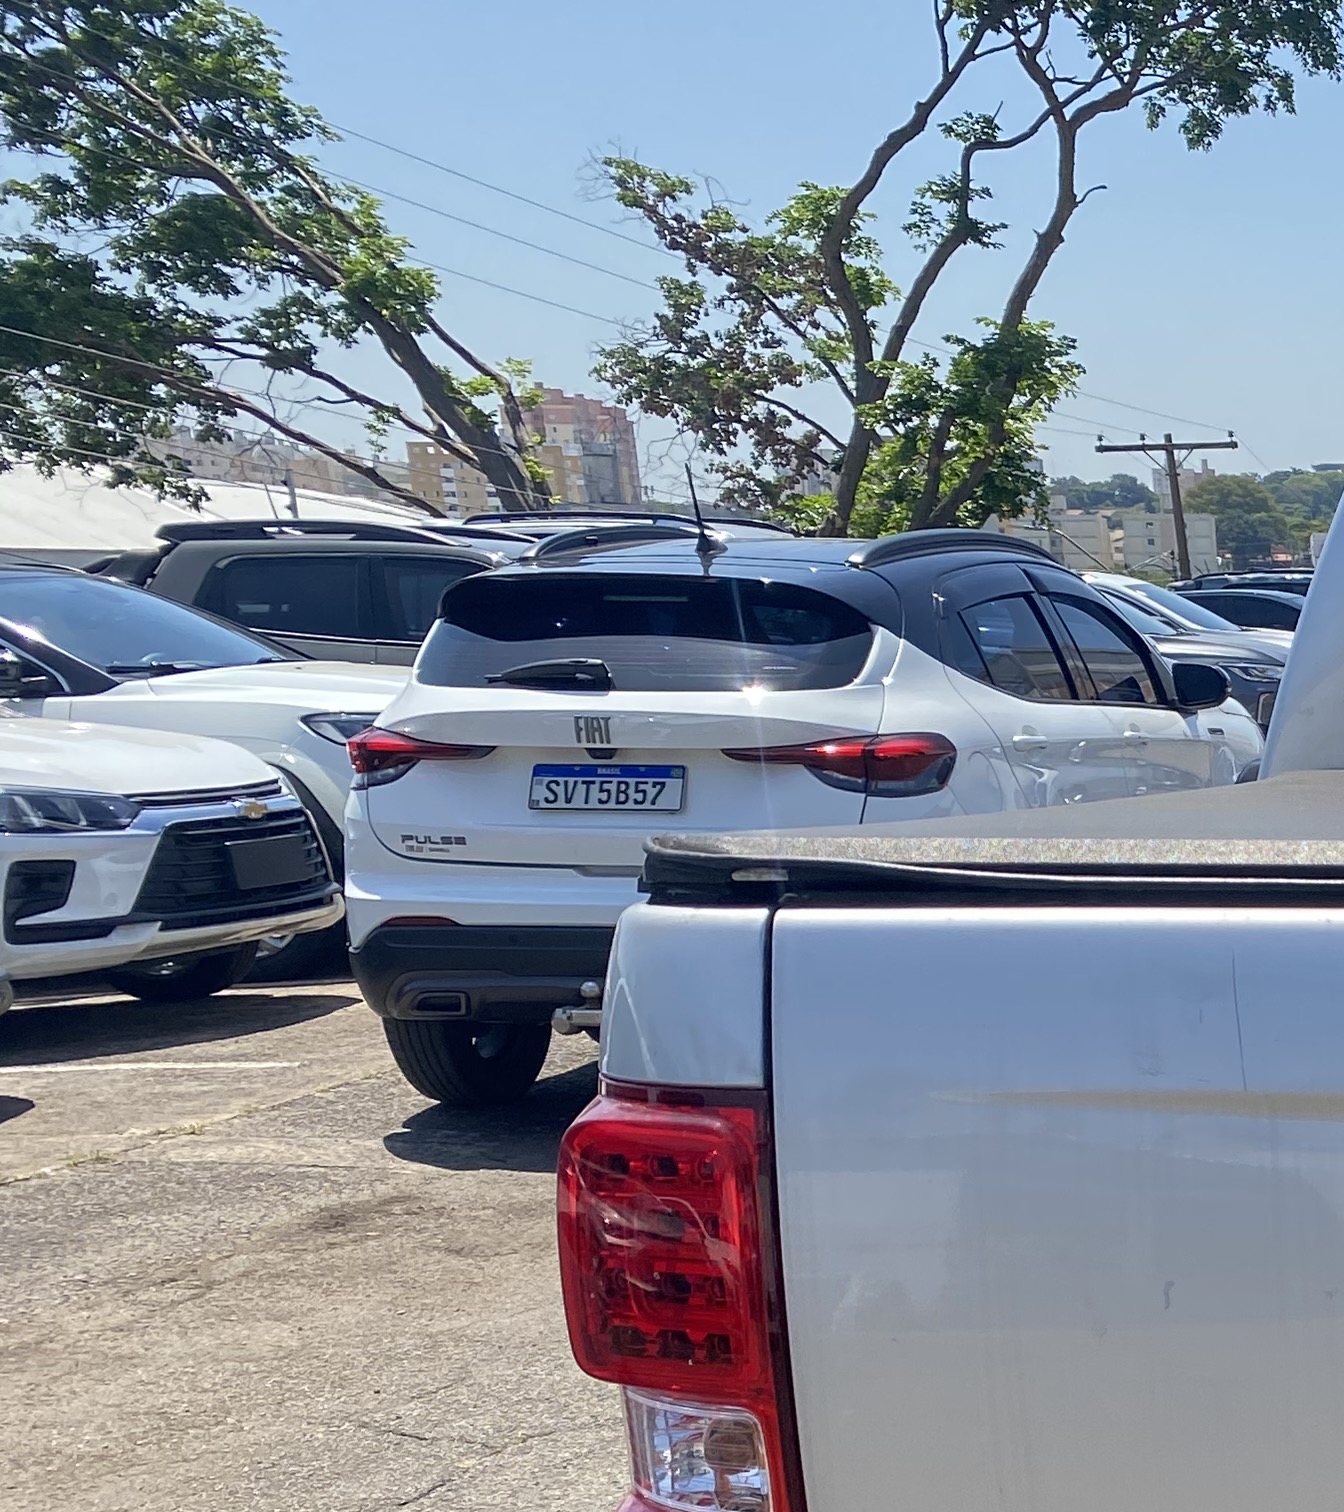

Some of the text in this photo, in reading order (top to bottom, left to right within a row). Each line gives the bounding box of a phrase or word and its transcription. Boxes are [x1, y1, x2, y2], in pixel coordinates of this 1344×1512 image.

[573, 715, 611, 744] FIAT
[543, 779, 666, 806] SVT5B57
[400, 834, 467, 846] PULSE
